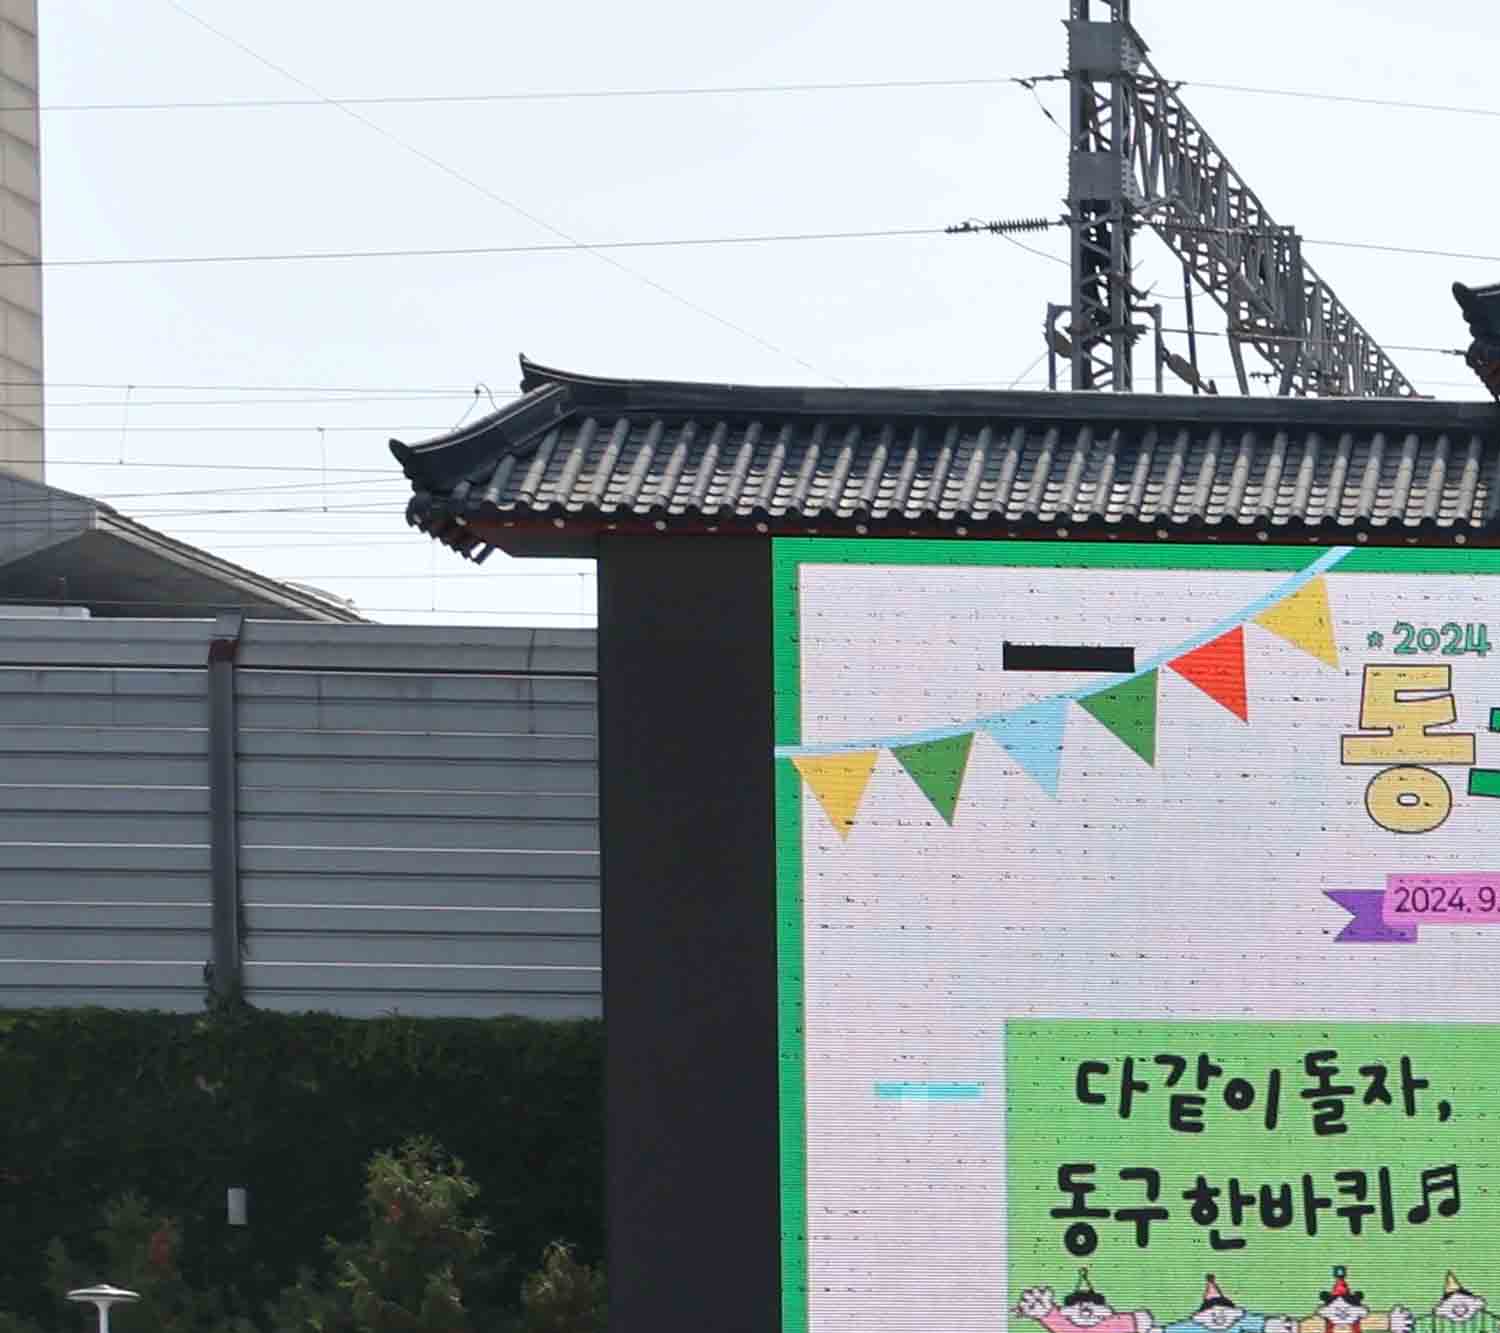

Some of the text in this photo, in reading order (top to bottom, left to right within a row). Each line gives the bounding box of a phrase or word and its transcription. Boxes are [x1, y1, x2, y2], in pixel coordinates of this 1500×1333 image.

[1393, 622, 1492, 656] 2024
[1077, 1049, 1454, 1136] 다같이 돌자,
[1050, 1163, 1395, 1257] 동구 한바퀴
